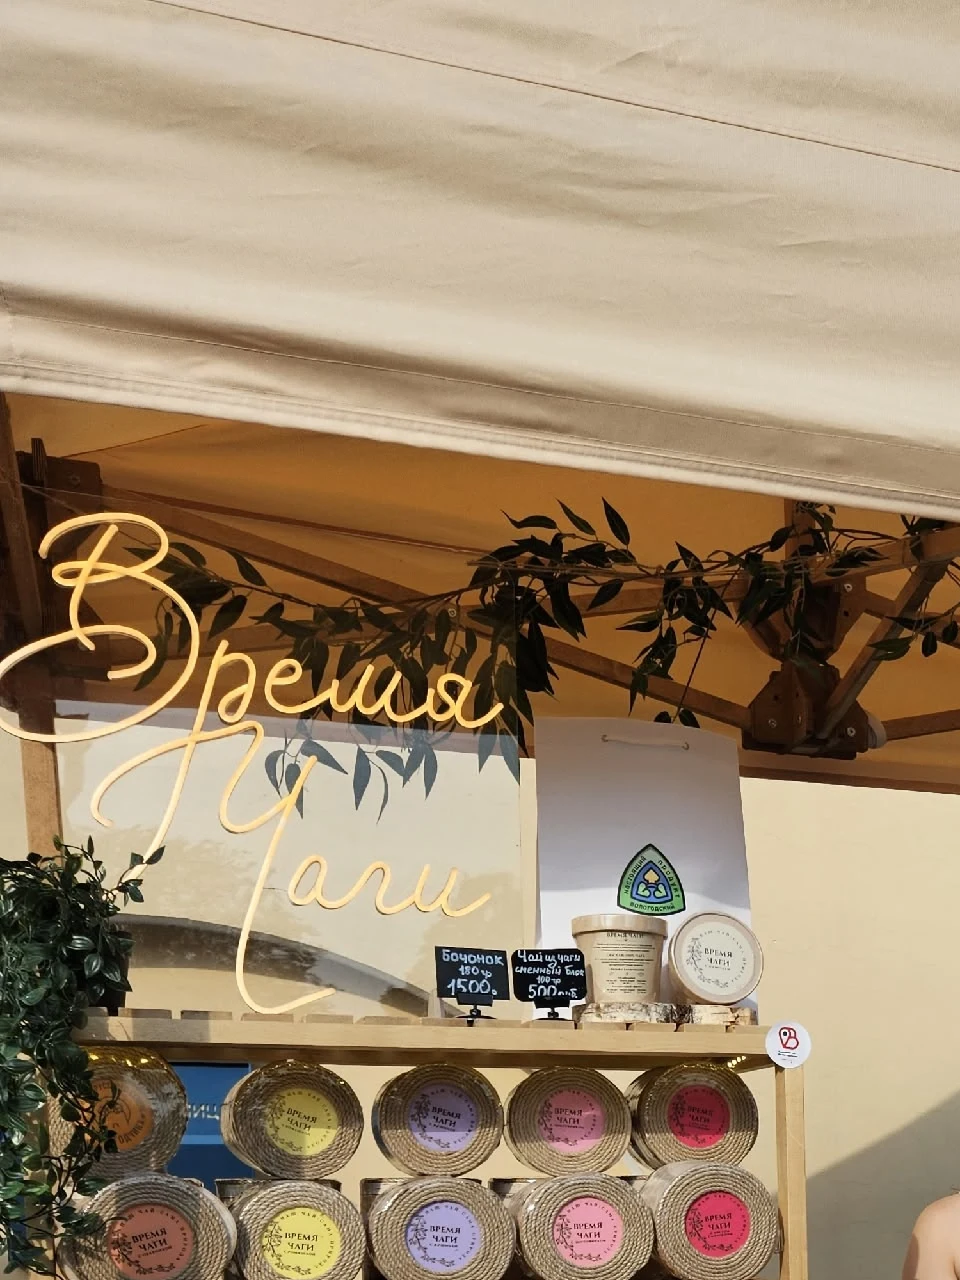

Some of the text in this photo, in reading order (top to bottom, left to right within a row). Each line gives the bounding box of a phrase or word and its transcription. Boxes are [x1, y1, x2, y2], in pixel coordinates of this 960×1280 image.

[0, 511, 503, 880] Время
[91, 722, 492, 1015] Чаги
[658, 860, 681, 898] ПРОДУКТ
[442, 949, 505, 966] Бочонок
[517, 950, 542, 962] Чай
[545, 953, 557, 967] из
[559, 954, 581, 963] чаги
[704, 948, 733, 958] ВРЕМЯ
[706, 958, 731, 967] ЧАГИ
[458, 965, 480, 976] 180
[515, 963, 562, 975] сменный
[528, 984, 558, 998] 500
[287, 1108, 317, 1124] ВРЕМЯ
[431, 1106, 462, 1120] ВРЕМЯ
[554, 1108, 583, 1117] ВРЕМЯ
[287, 1117, 312, 1132] ЧАГИ
[432, 1116, 457, 1128] ЧАГИ
[556, 1117, 580, 1125] ЧАГИ
[704, 1213, 733, 1223] ВРЕМЯ
[429, 1225, 461, 1235] ВРЕМЯ
[573, 1222, 604, 1231] ВРЕМЯ
[707, 1222, 732, 1231] ЧАГИ
[131, 1227, 168, 1244] ВРЕМЯ
[284, 1232, 319, 1242] ВРЕМЯ
[432, 1235, 459, 1244] ЧАГИ
[576, 1232, 602, 1240] ЧАГИ
[138, 1238, 169, 1252] ЧАГИ
[287, 1242, 315, 1252] ЧАГИ
